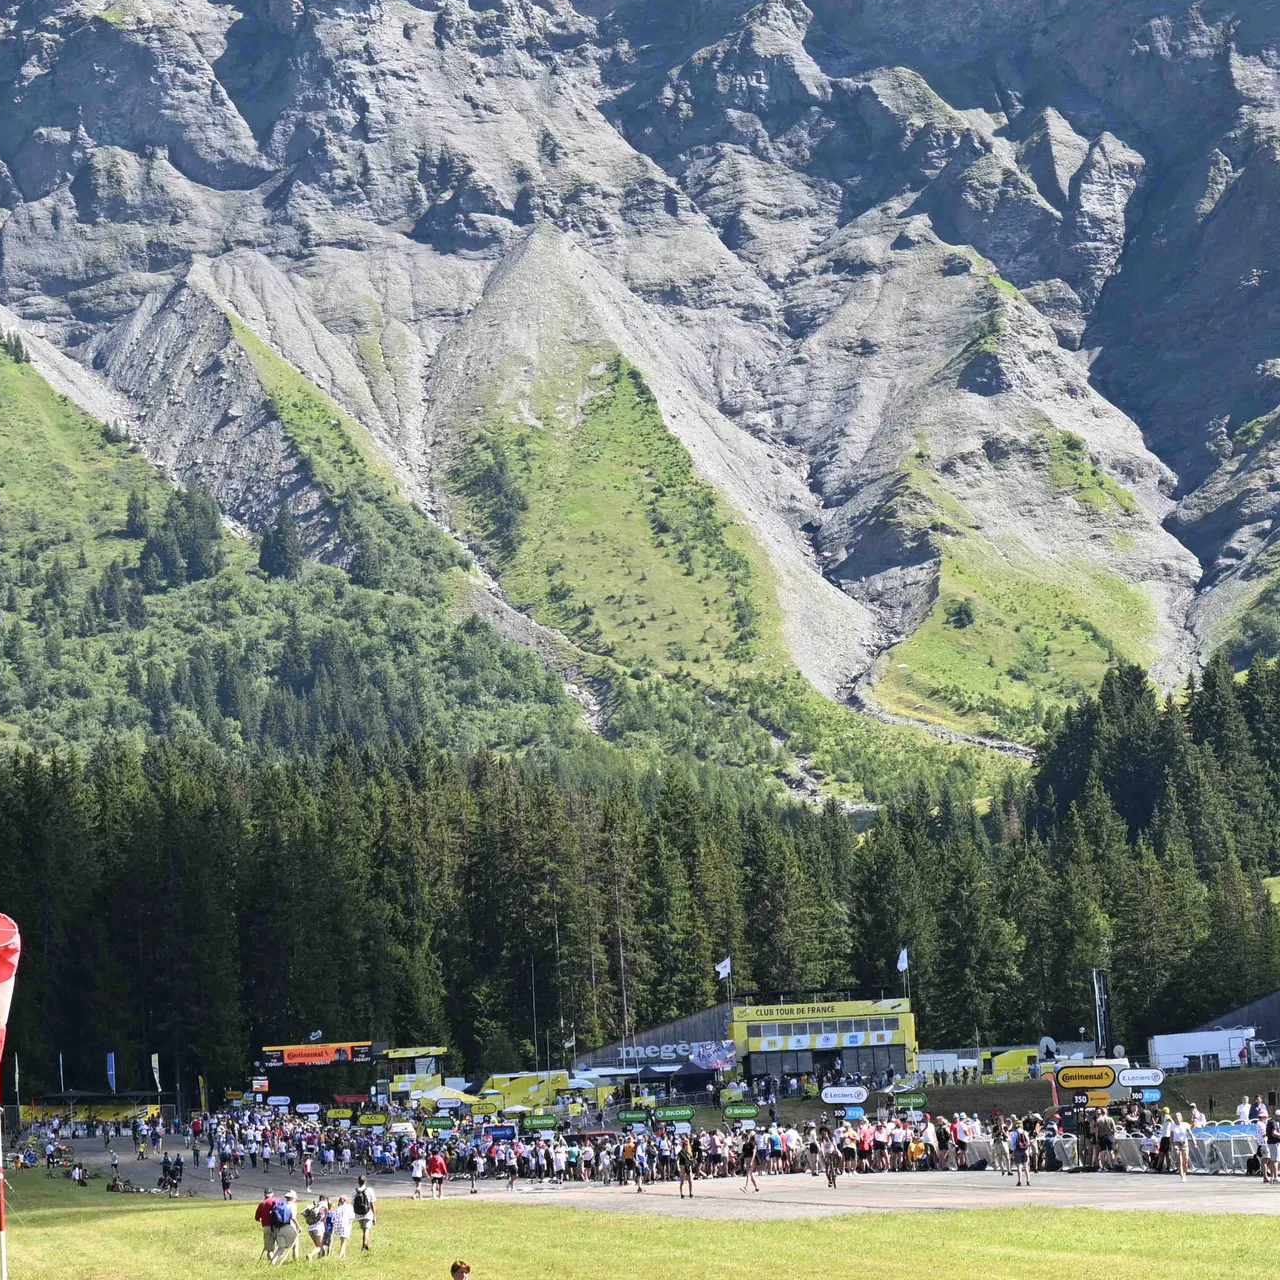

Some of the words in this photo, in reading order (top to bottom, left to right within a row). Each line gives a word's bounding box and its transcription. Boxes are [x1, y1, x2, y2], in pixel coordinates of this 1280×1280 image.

[755, 1008, 774, 1017] CLUB
[776, 1007, 795, 1016] TOUR
[796, 1007, 806, 1015] DE
[807, 1005, 836, 1014] FRANCE
[1061, 1072, 1104, 1083] Continental
[1074, 1095, 1088, 1104] 350
[1131, 1092, 1143, 1100] 300
[834, 1109, 846, 1117] 300
